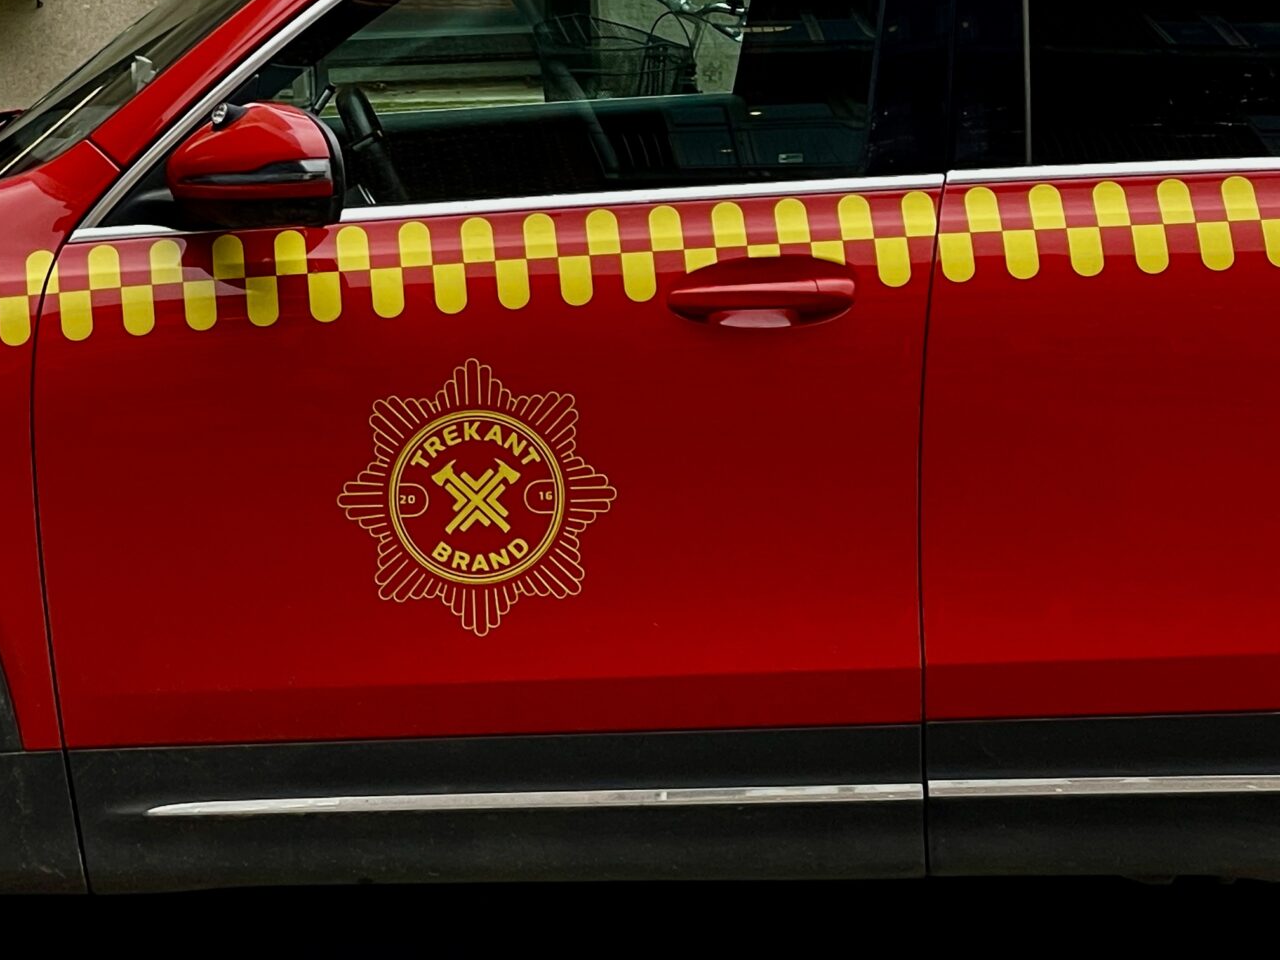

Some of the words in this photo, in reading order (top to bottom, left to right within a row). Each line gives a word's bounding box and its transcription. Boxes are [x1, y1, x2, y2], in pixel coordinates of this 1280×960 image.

[410, 421, 542, 468] TREKANT
[399, 494, 416, 505] 20
[538, 490, 553, 501] 16
[431, 537, 530, 572] BRAND
